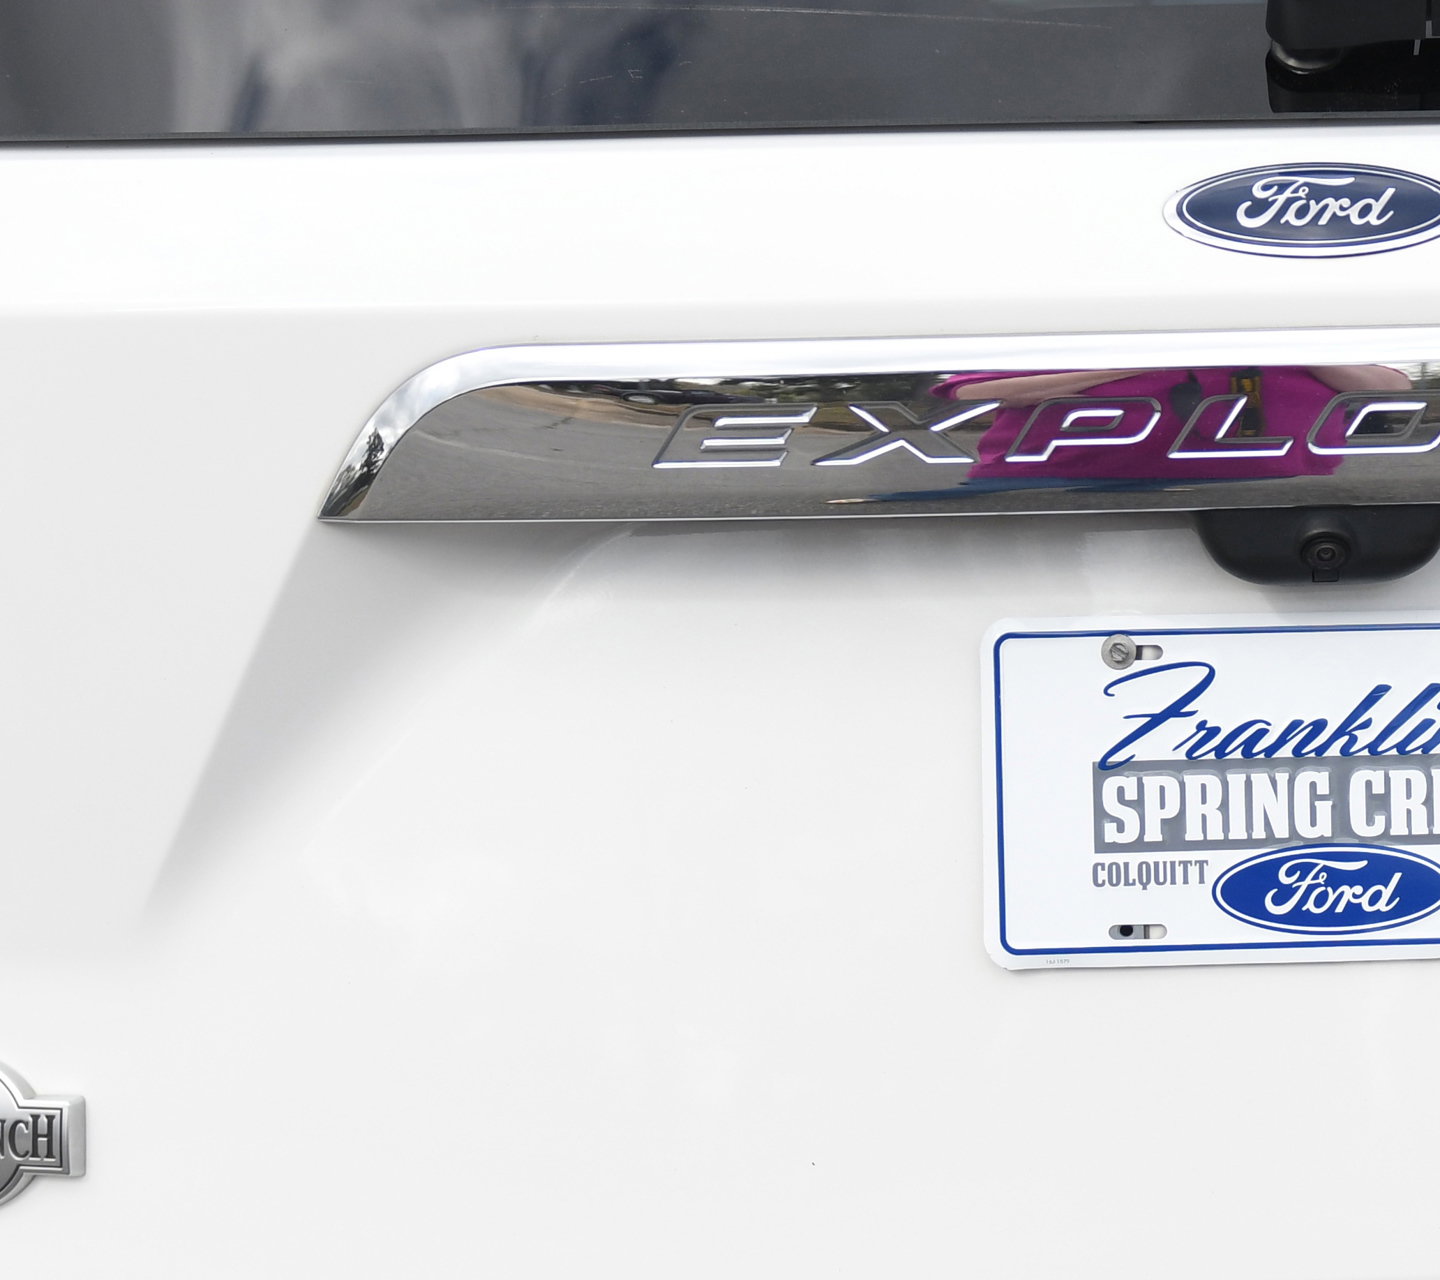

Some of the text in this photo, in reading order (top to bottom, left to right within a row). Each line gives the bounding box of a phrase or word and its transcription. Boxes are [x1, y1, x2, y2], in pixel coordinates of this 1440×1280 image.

[1236, 175, 1397, 229] Ford
[1102, 768, 1332, 844] SPRING
[1091, 859, 1209, 888] COLQUITT
[1263, 858, 1402, 916] Ford
